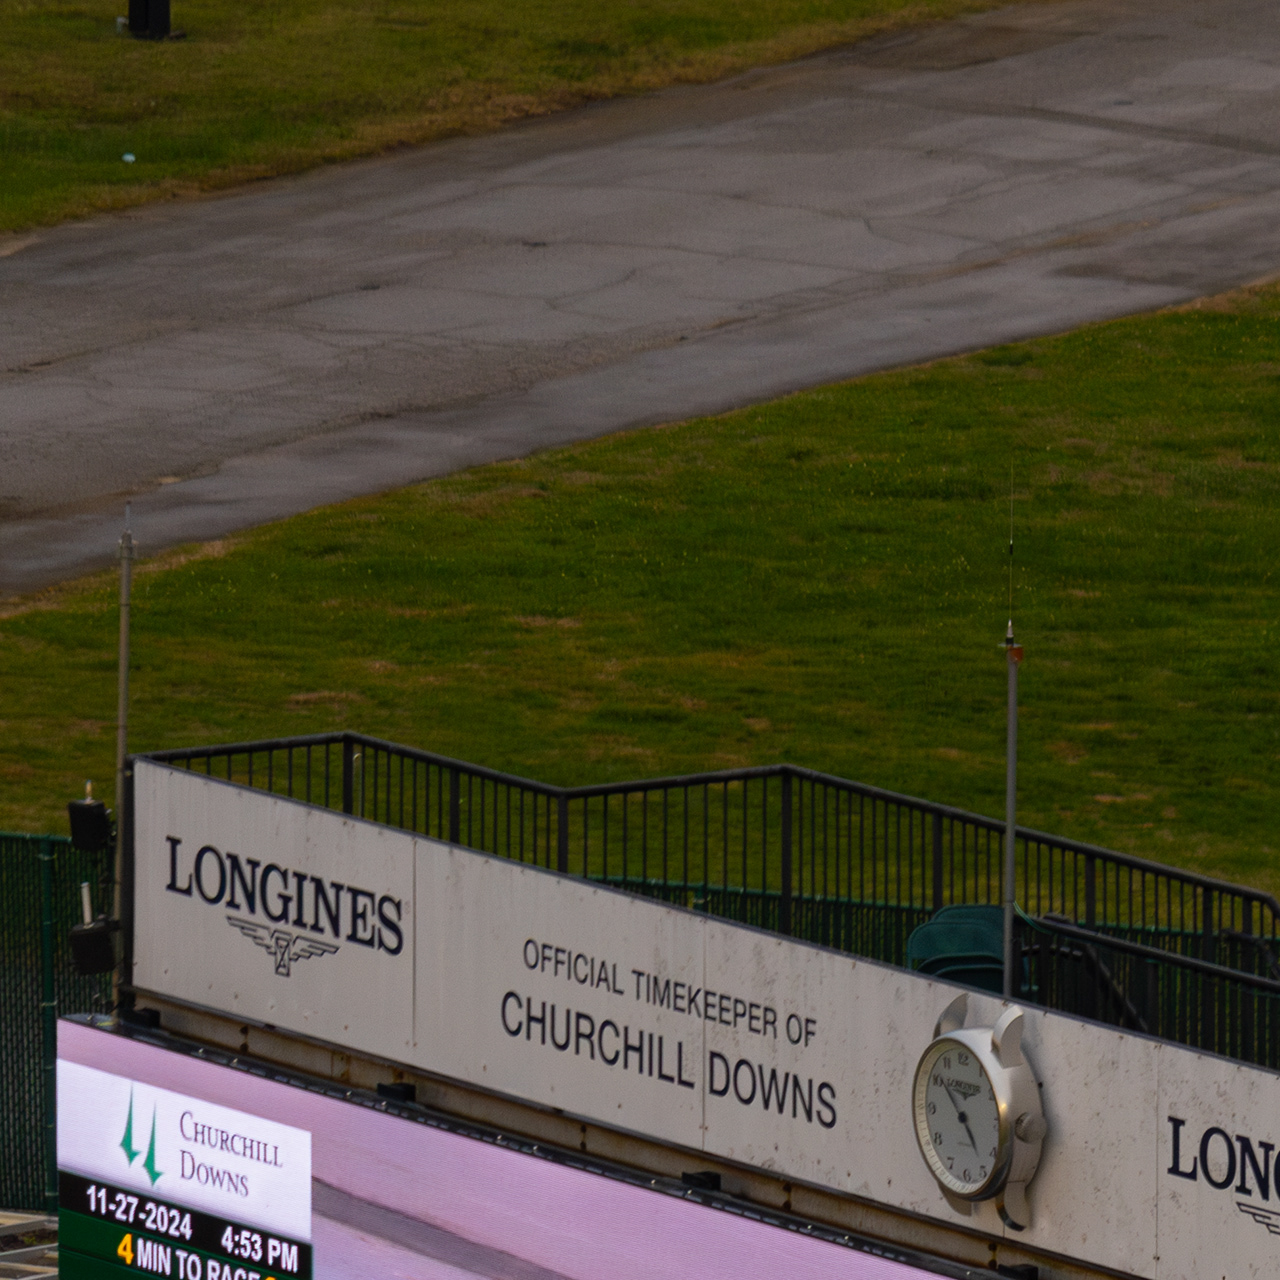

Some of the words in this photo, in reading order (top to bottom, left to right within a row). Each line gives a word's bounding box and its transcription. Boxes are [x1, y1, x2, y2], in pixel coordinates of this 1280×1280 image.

[165, 835, 404, 956] LONGINES
[523, 938, 625, 995] OFFICIAL
[631, 969, 778, 1040] TIMEKEEPER
[786, 1013, 817, 1048] OF
[501, 991, 695, 1090] CHURCHILL
[708, 1050, 837, 1130] DOWNS
[179, 1110, 283, 1168] CHURCHILL
[180, 1150, 249, 1197] DOWNS
[86, 1185, 192, 1240] 11-27-2024
[220, 1226, 263, 1262] 4:53
[267, 1241, 298, 1273] PM
[117, 1233, 134, 1265] 4
[136, 1237, 171, 1276] MIN
